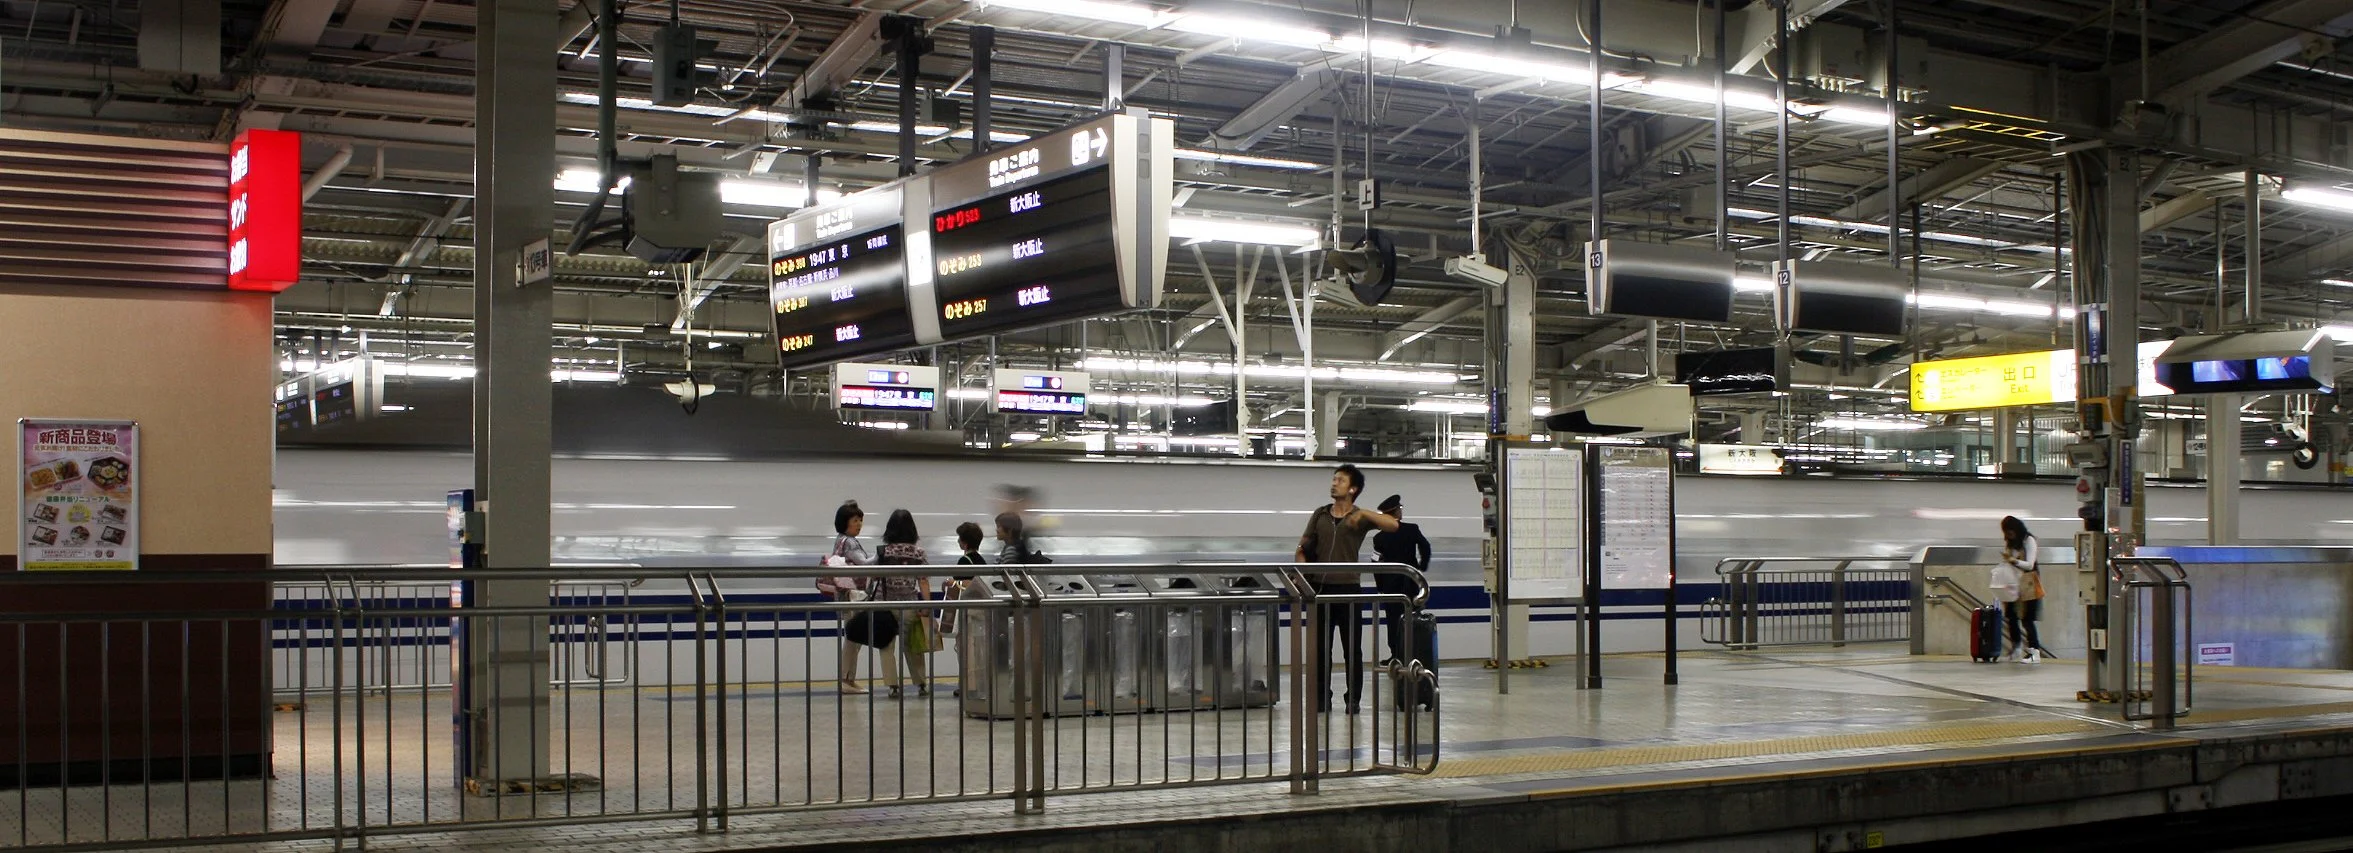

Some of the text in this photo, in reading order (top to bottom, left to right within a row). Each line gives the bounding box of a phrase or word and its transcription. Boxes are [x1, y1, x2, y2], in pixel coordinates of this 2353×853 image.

[1361, 184, 1372, 205] 上
[230, 192, 248, 231] サンド
[935, 210, 965, 233] ひかり
[1009, 191, 1042, 213] 新大阪止
[939, 256, 967, 276] のぞみ
[1012, 238, 1044, 260] 新大阪止
[1591, 253, 1601, 267] 13
[774, 259, 796, 276] のぞみ
[1779, 272, 1789, 285] 12
[776, 298, 798, 314] のぞみ
[830, 284, 855, 302] 新大阪止
[944, 285, 1051, 320] のぞみ 257 新大阪止
[782, 336, 803, 352] のぞみ
[836, 325, 860, 342] 新大阪止
[2003, 366, 2036, 382] 出口
[2010, 384, 2031, 394] Exit
[38, 428, 118, 446] 新商品登場
[1727, 449, 1757, 457] 新大阪
